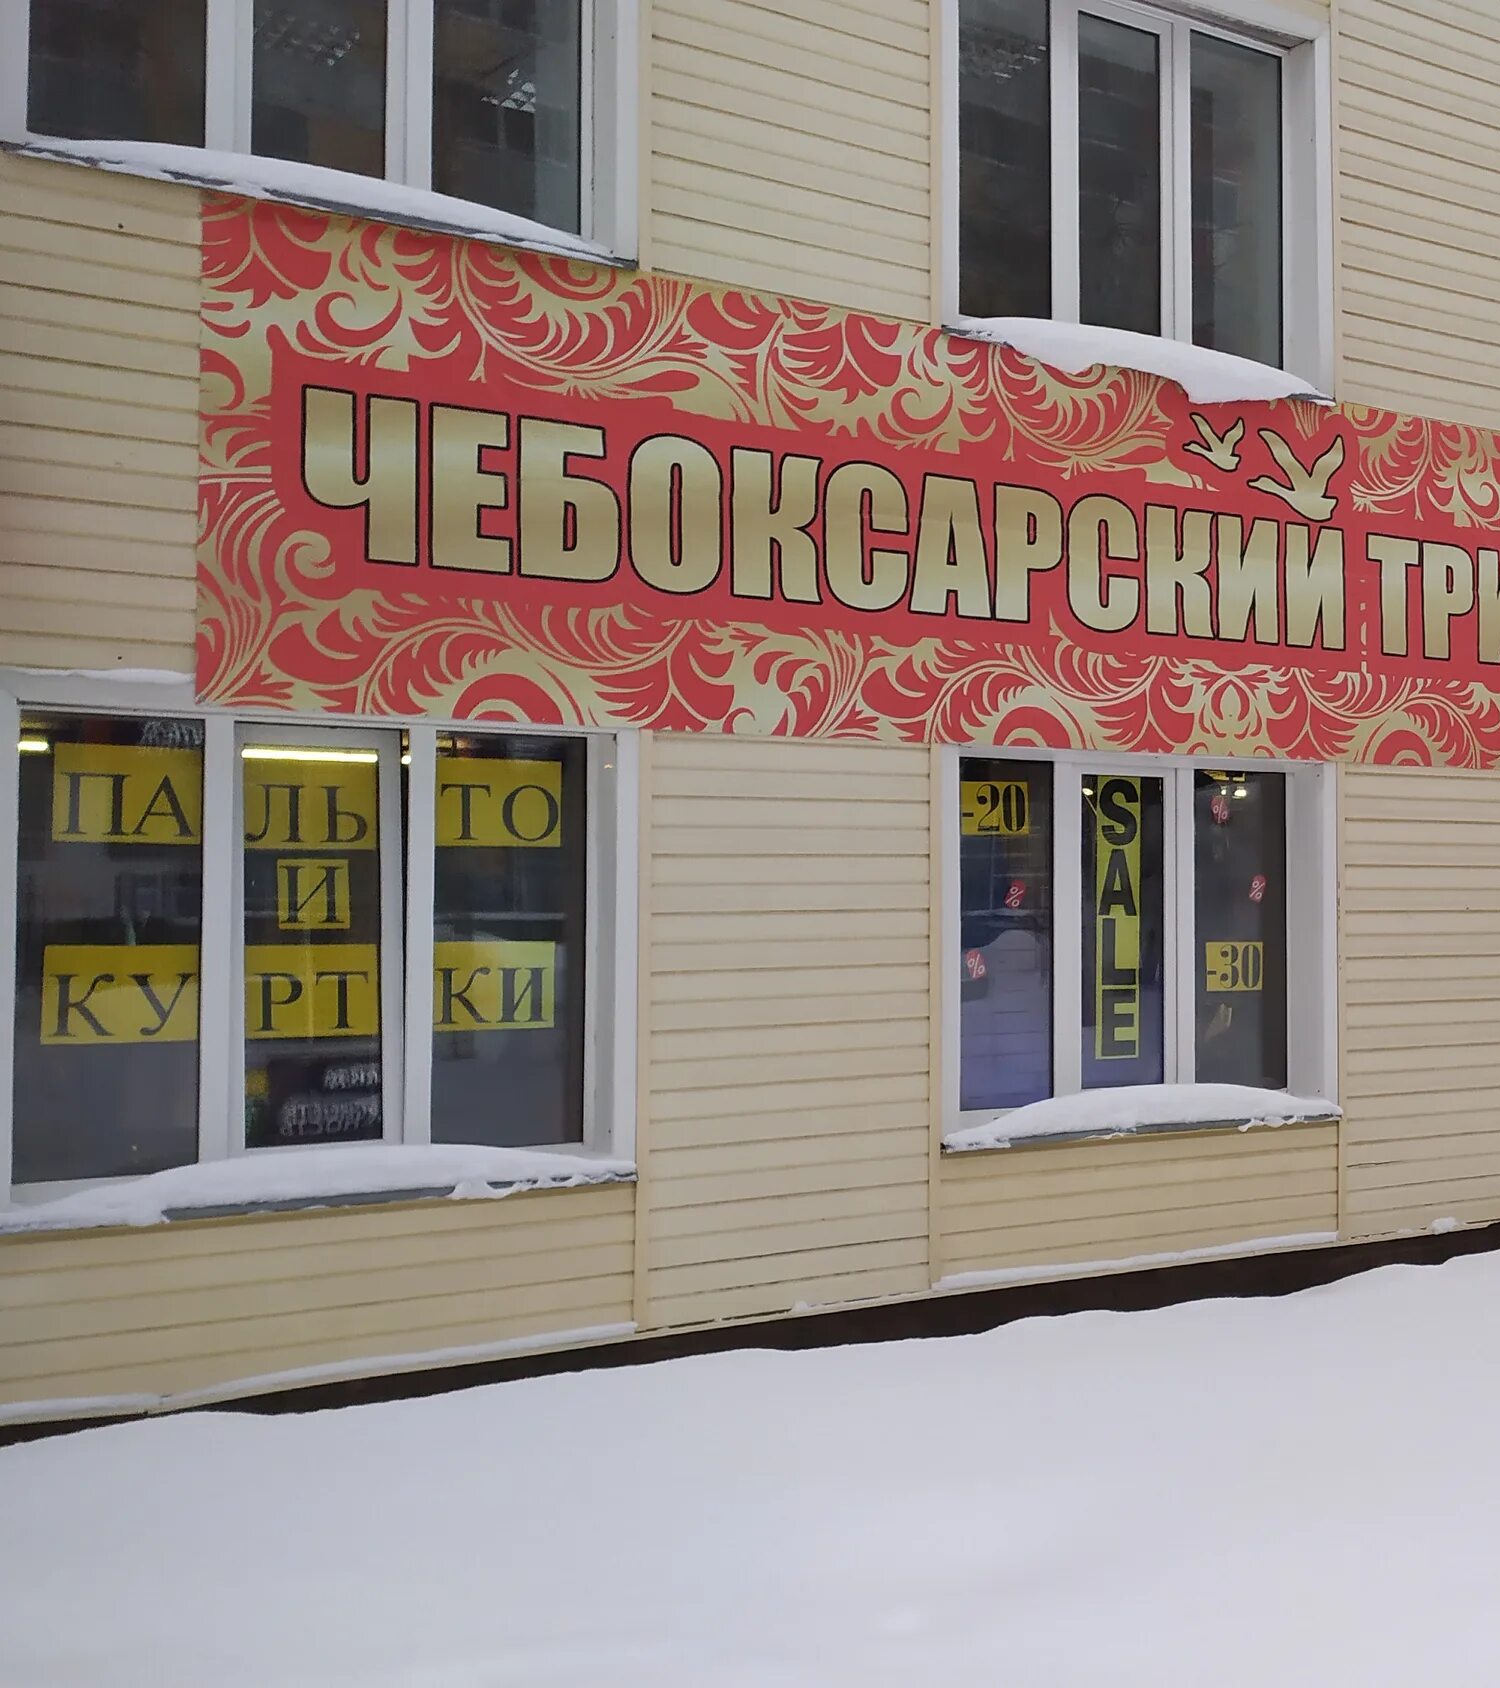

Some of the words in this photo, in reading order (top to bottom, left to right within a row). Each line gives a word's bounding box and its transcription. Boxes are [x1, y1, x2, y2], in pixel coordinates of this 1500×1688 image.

[302, 385, 1347, 650] ЧЕБОКСАРСКИЙ
[962, 782, 1026, 833] -20
[284, 865, 346, 924] И
[1099, 777, 1140, 1057] SALE
[1207, 943, 1262, 990] -30
